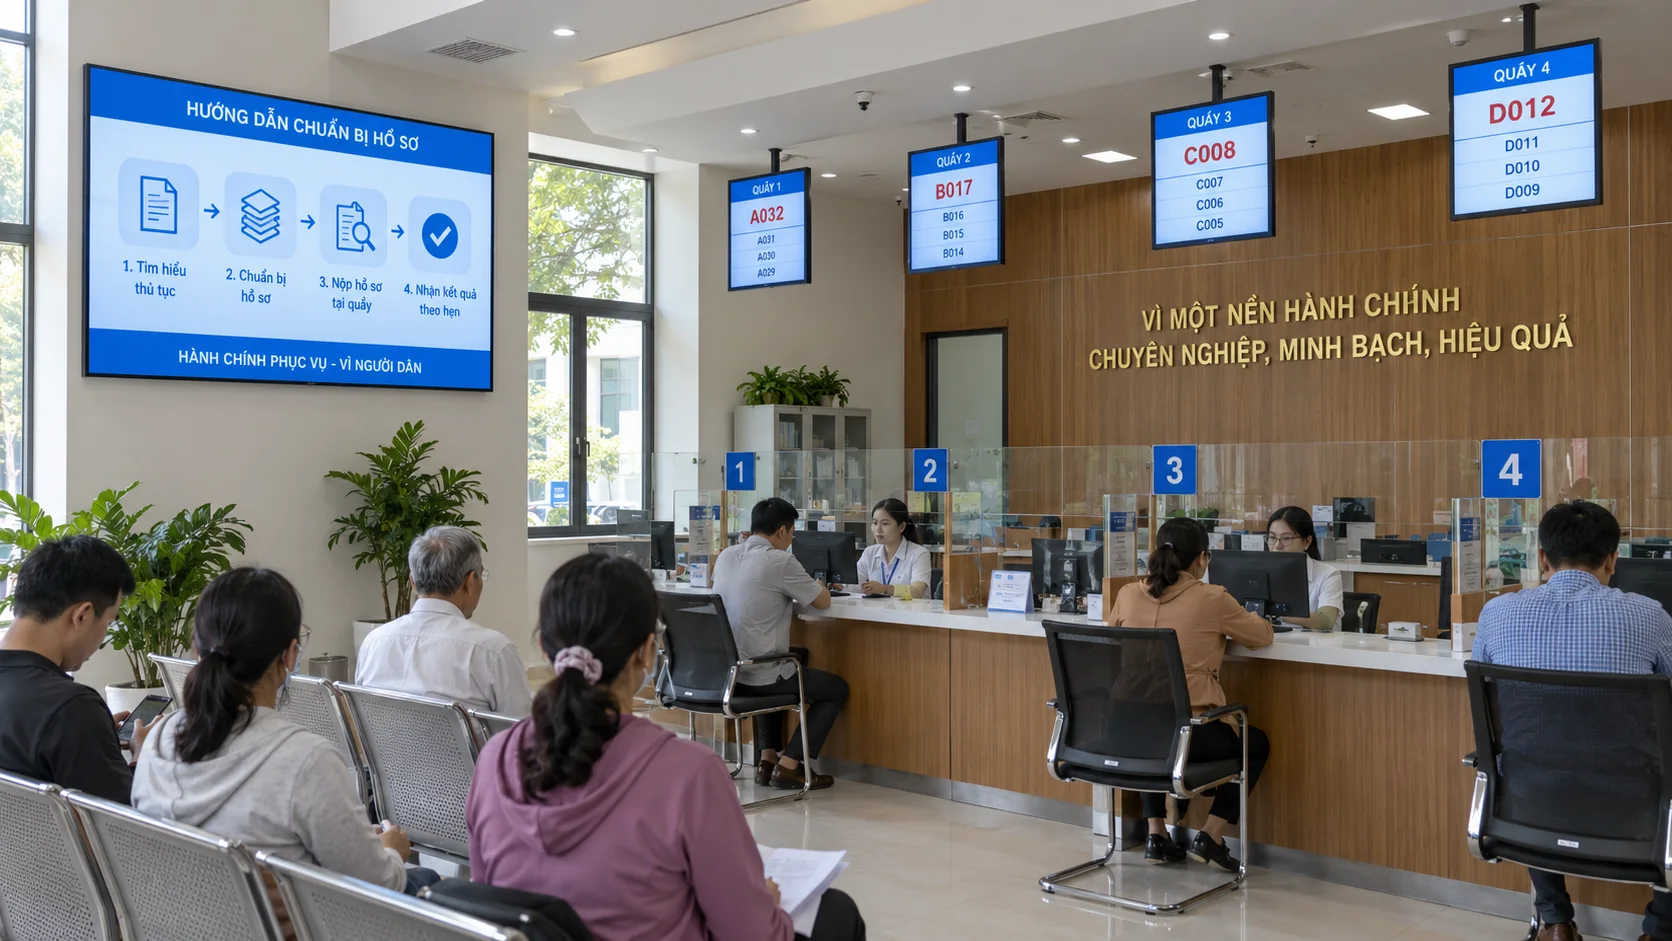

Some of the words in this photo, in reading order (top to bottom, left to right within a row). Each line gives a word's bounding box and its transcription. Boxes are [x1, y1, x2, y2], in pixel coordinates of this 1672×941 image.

[1541, 61, 1550, 74] 4
[1224, 111, 1232, 123] 3
[1489, 95, 1556, 124] D012
[187, 101, 248, 125] HƯỚNG
[254, 107, 288, 131] DẪN
[354, 128, 369, 147] BỊ
[399, 135, 419, 151] SƠ
[1505, 136, 1538, 152] D011
[965, 153, 971, 163] 2
[1184, 140, 1236, 165] C008
[1505, 159, 1540, 175] D010
[777, 181, 781, 191] 1
[936, 179, 973, 200] B017
[1196, 176, 1223, 190] C007
[1505, 183, 1540, 199] D009
[1196, 197, 1223, 211] C006
[750, 205, 784, 224] A032
[943, 210, 964, 222] B016
[1196, 218, 1224, 231] C005
[757, 234, 775, 245] A031
[943, 228, 964, 240] B015
[757, 251, 776, 261] A030
[943, 247, 964, 258] B014
[123, 260, 133, 273] 1.
[162, 261, 187, 277] hiểu
[757, 267, 776, 278] A029
[226, 268, 236, 281] 2.
[239, 268, 273, 284] Chuẩn
[276, 272, 287, 287] bị
[319, 276, 329, 288] 3.
[332, 277, 353, 292] Nộp
[370, 282, 383, 292] sơ
[158, 284, 176, 299] tục
[258, 294, 272, 304] sơ
[404, 284, 413, 295] 4.
[416, 284, 440, 299] Nhận
[443, 285, 457, 298] kết
[460, 288, 477, 301] quả
[332, 297, 345, 311] tại
[419, 304, 440, 316] theo
[443, 305, 460, 319] hẹn
[1141, 304, 1162, 331] VÌ
[1170, 301, 1218, 334] MỘT
[1228, 294, 1275, 326] NỀN
[1285, 292, 1354, 322] HÀNH
[1089, 341, 1173, 370] CHUYÊN
[1182, 335, 1270, 368] NGHIỆP,
[1279, 336, 1341, 361] MINH
[1352, 331, 1430, 363] BẠCH,
[1439, 322, 1502, 358] HIỆU
[1511, 313, 1573, 352] QUẢ
[178, 348, 219, 365] HÀNH
[223, 351, 266, 367] CHÍNH
[271, 355, 306, 371] PHỤC
[310, 357, 327, 372] VỤ
[340, 356, 351, 371] VÌ
[355, 358, 394, 373] NGƯỜI
[397, 359, 422, 374] DÂN
[735, 461, 744, 483] 1
[923, 458, 937, 483] 2
[1166, 456, 1184, 485] 3
[1499, 453, 1523, 486] 4
